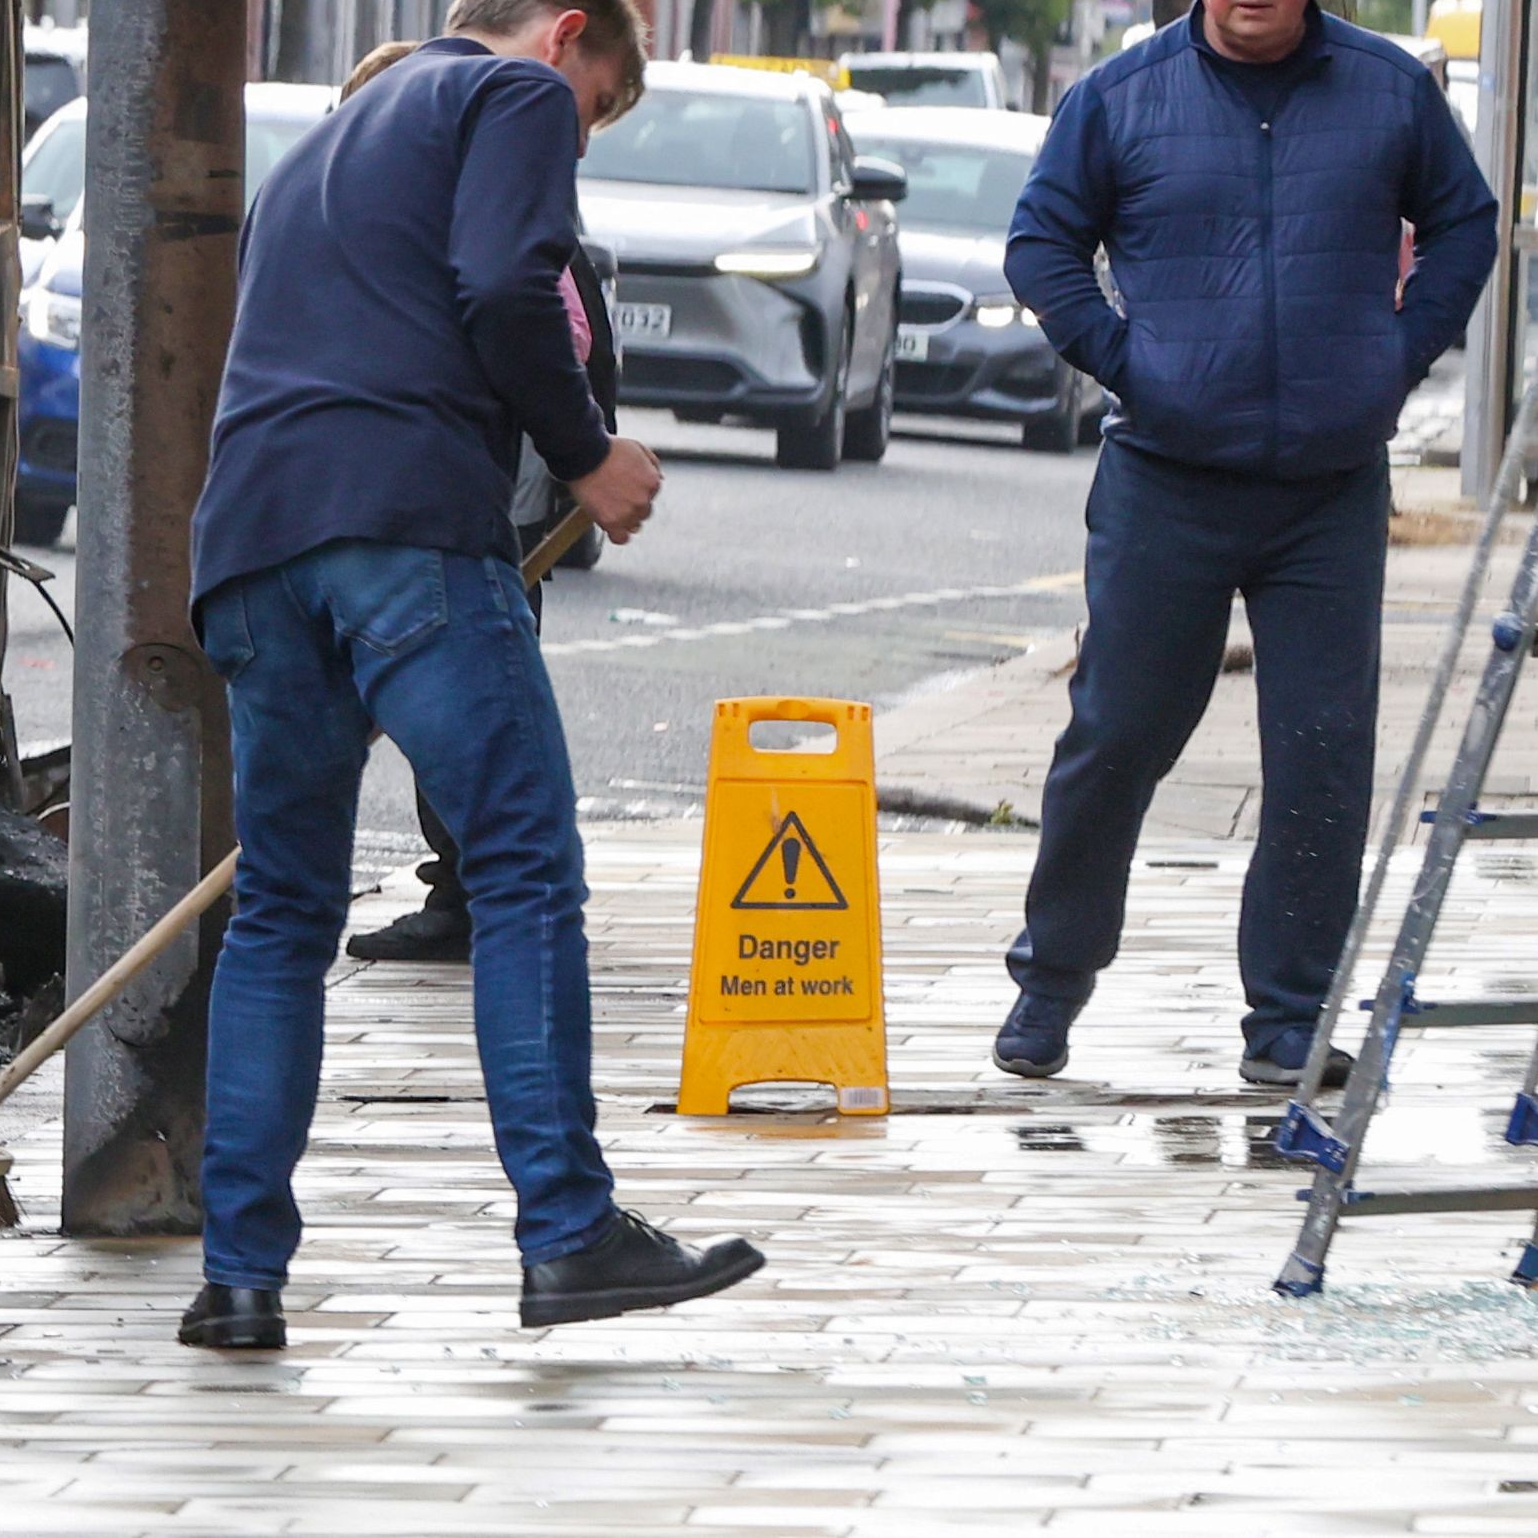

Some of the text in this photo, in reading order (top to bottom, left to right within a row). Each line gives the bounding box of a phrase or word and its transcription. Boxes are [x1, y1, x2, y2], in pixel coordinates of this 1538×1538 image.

[738, 933, 840, 966] Danger
[721, 974, 854, 996] Men at work
